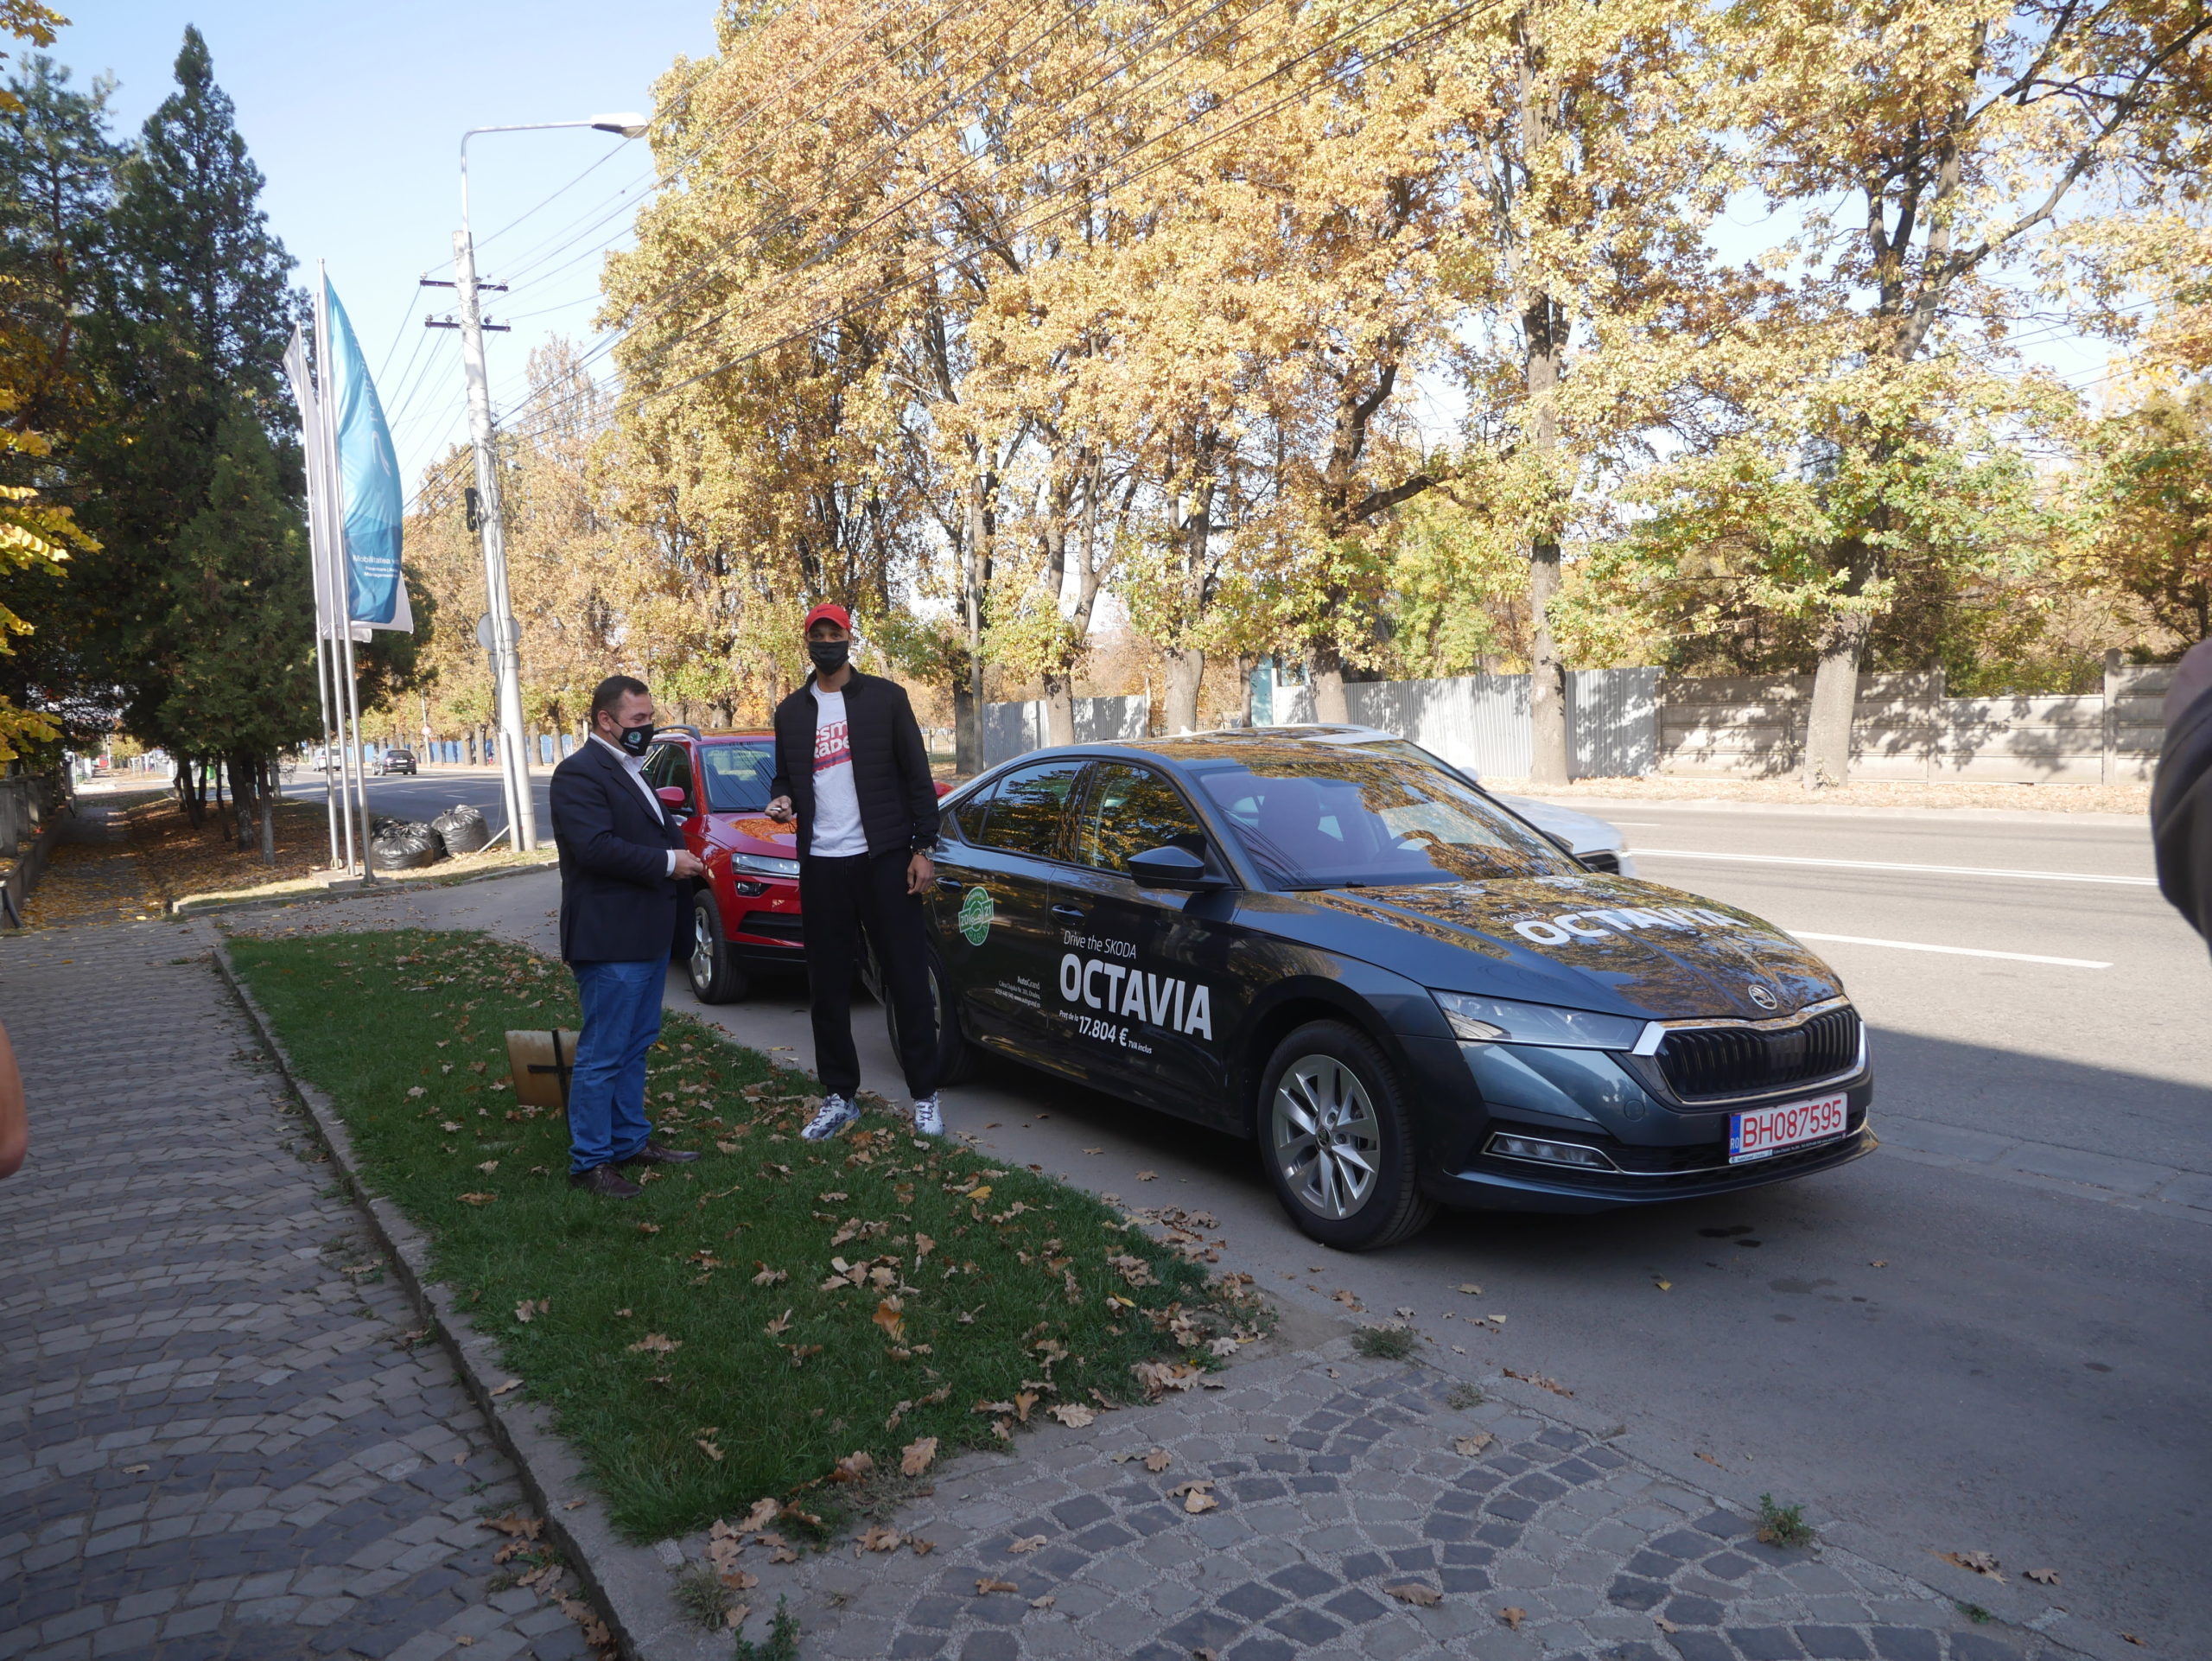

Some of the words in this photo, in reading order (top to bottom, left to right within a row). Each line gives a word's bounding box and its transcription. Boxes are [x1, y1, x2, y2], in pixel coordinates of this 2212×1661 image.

[960, 913, 969, 926] 20
[983, 904, 992, 918] 21
[1490, 910, 1547, 924] SKODA
[1513, 907, 1751, 945] OCTAVIA
[969, 925, 988, 943] RABLA
[1064, 930, 1085, 949] Drive
[1087, 934, 1103, 951] the
[1103, 939, 1137, 959] SKODA
[1017, 976, 1040, 990] AutoGrand
[1059, 953, 1213, 1042] OCTAVIA
[1078, 1015, 1116, 1043] 17.804
[1119, 1027, 1129, 1047] €
[1128, 1040, 1138, 1050] TVA
[1137, 1042, 1153, 1054] inclus
[1743, 1099, 1841, 1148] BH087595
[1730, 1136, 1739, 1151] RO
